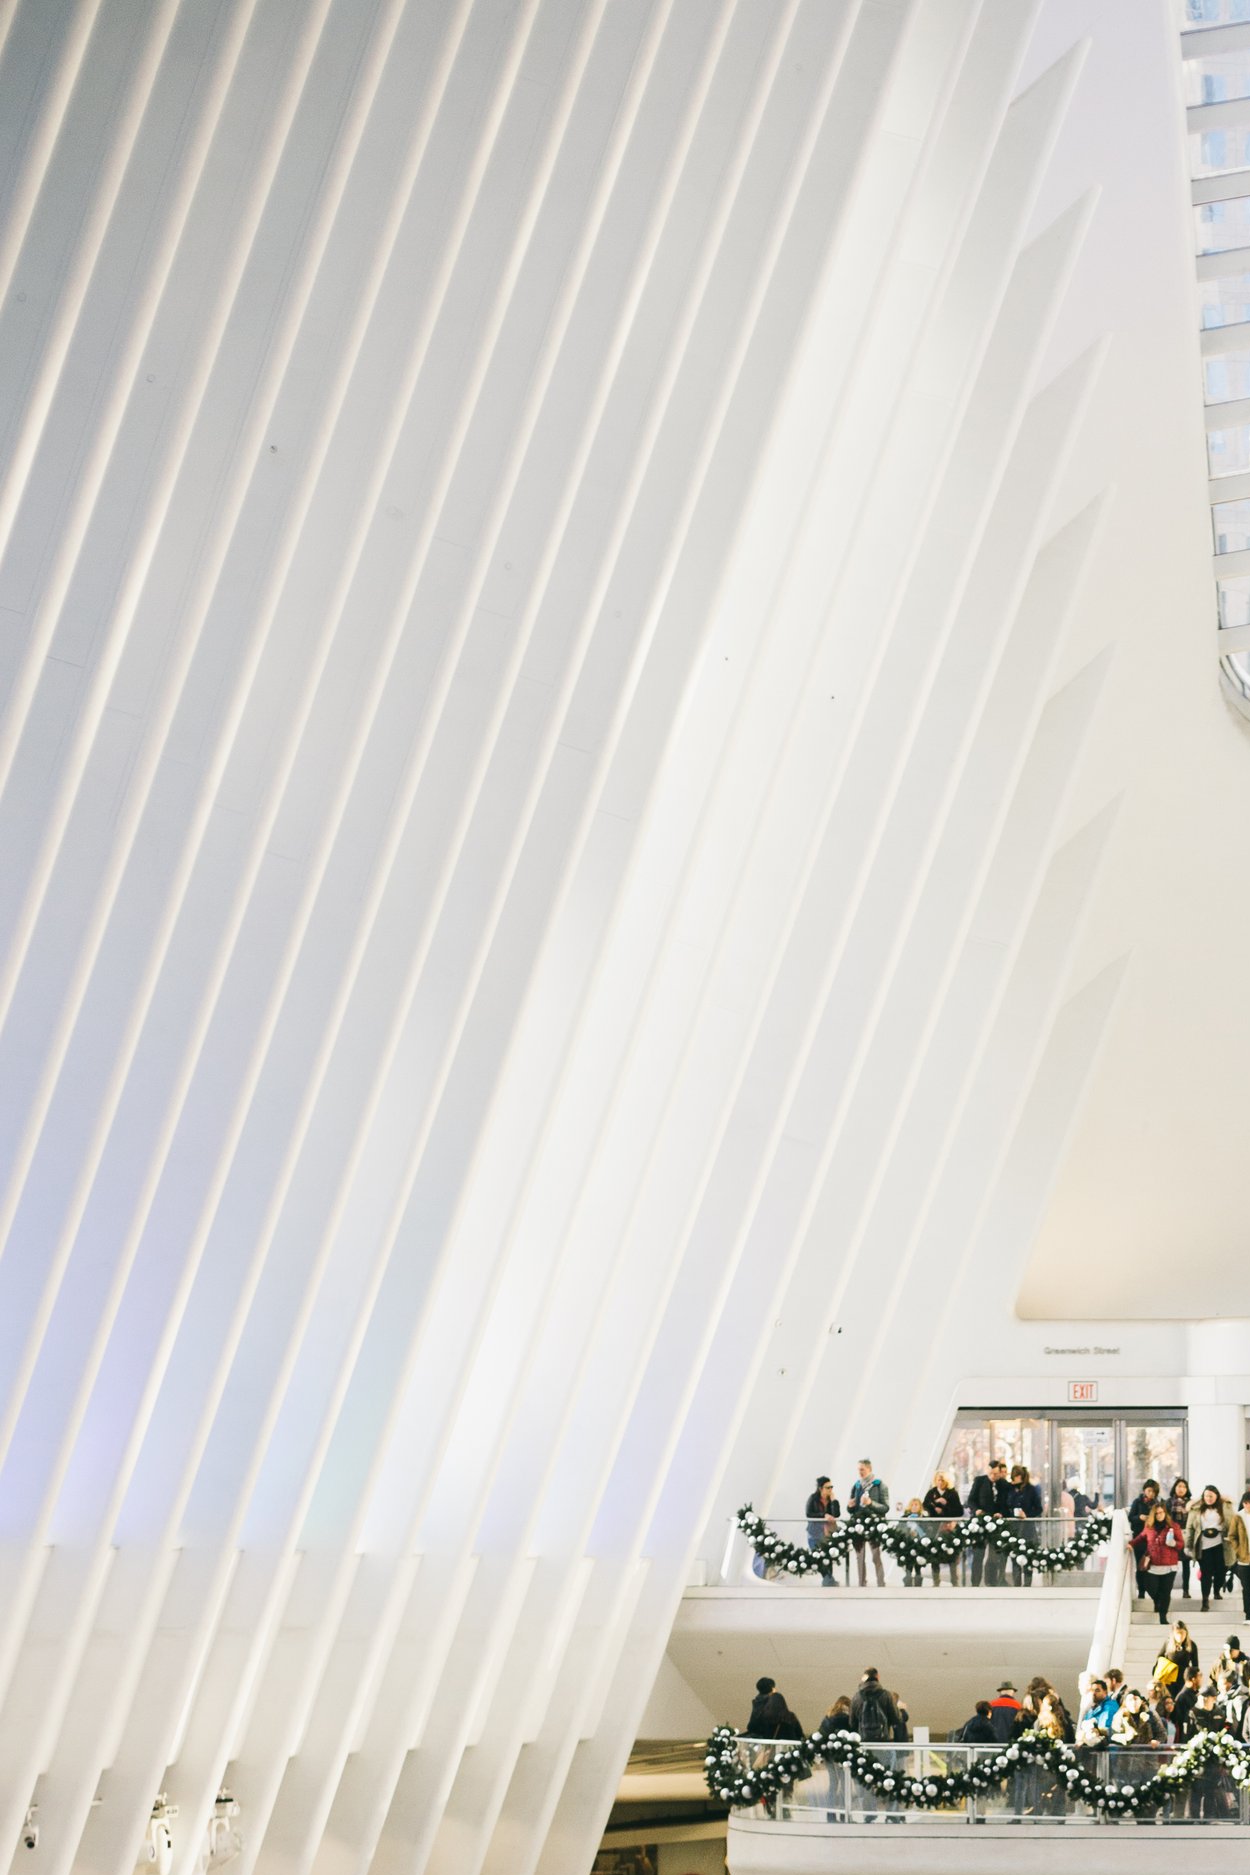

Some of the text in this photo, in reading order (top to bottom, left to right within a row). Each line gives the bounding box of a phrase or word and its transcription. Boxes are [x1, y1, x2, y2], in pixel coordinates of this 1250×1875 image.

[1044, 1346, 1120, 1355] Greenwich Street
[1073, 1384, 1094, 1399] EXIT
